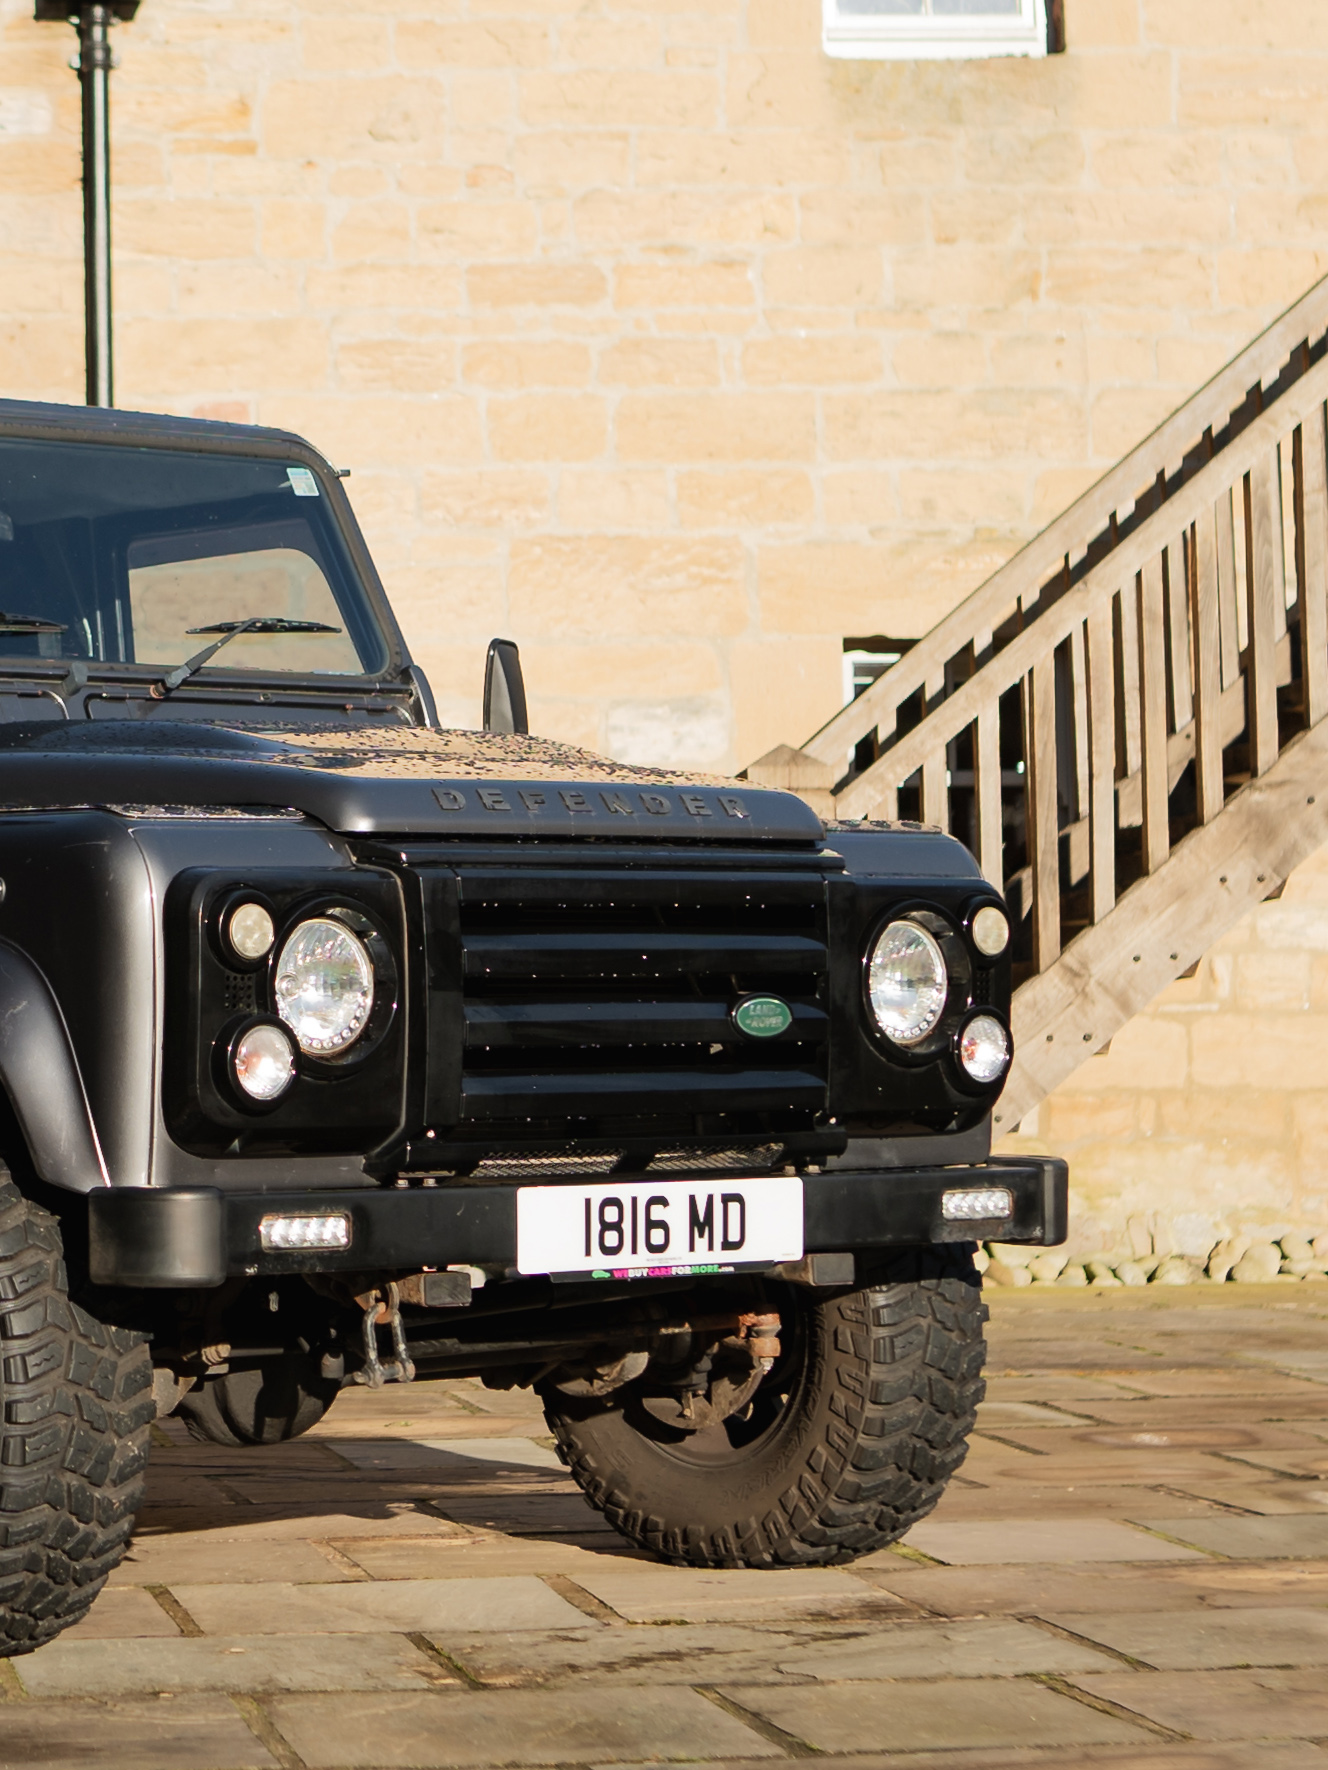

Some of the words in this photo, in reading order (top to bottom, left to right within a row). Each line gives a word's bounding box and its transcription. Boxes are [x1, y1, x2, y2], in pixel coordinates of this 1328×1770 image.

[430, 787, 750, 819] DEFENDER
[584, 1195, 670, 1258] 1816
[688, 1192, 746, 1253] MD
